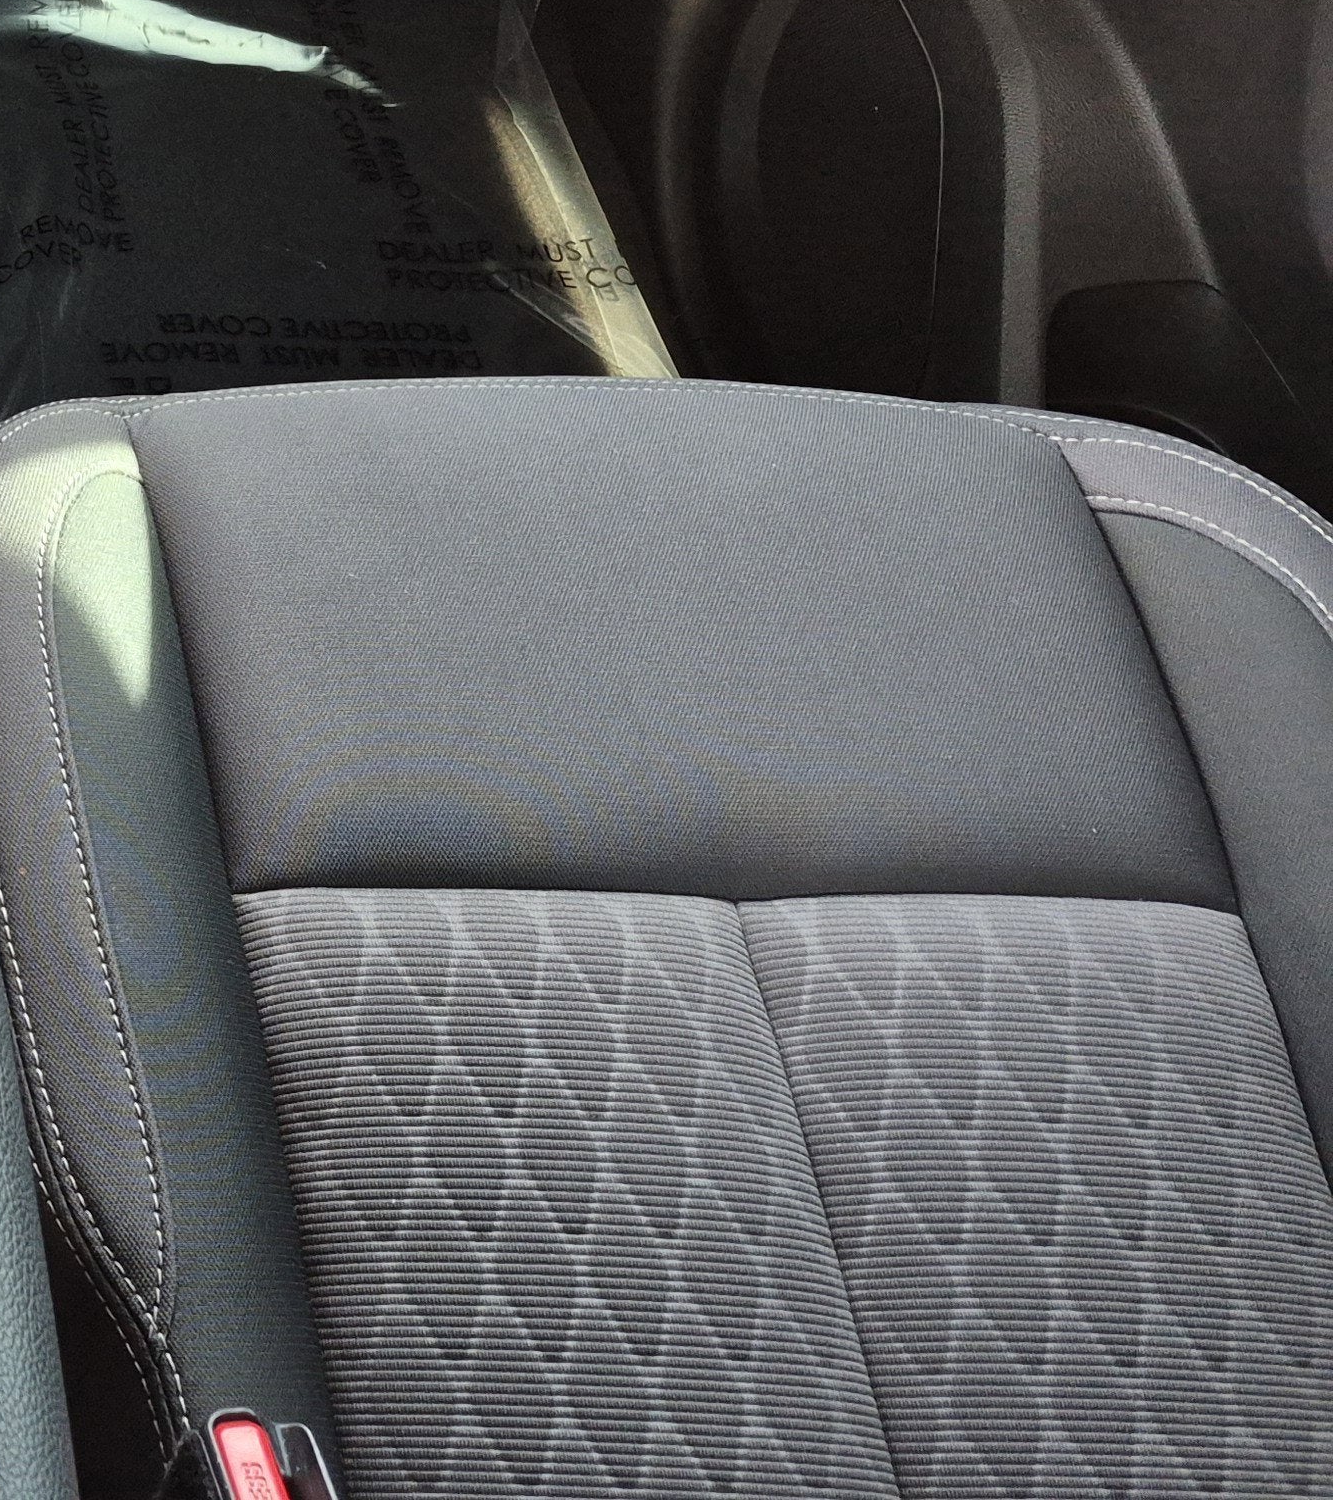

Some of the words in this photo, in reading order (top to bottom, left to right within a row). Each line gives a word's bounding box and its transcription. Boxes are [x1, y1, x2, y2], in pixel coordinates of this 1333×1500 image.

[18, 214, 134, 255] REMOVE
[375, 240, 495, 263] DEALER
[515, 237, 597, 263] MUST
[156, 313, 273, 339] COVER
[279, 317, 473, 344] PROTECTIVE
[99, 341, 240, 367] REMOVE
[257, 344, 341, 370] MUST
[361, 347, 484, 372] DEALER
